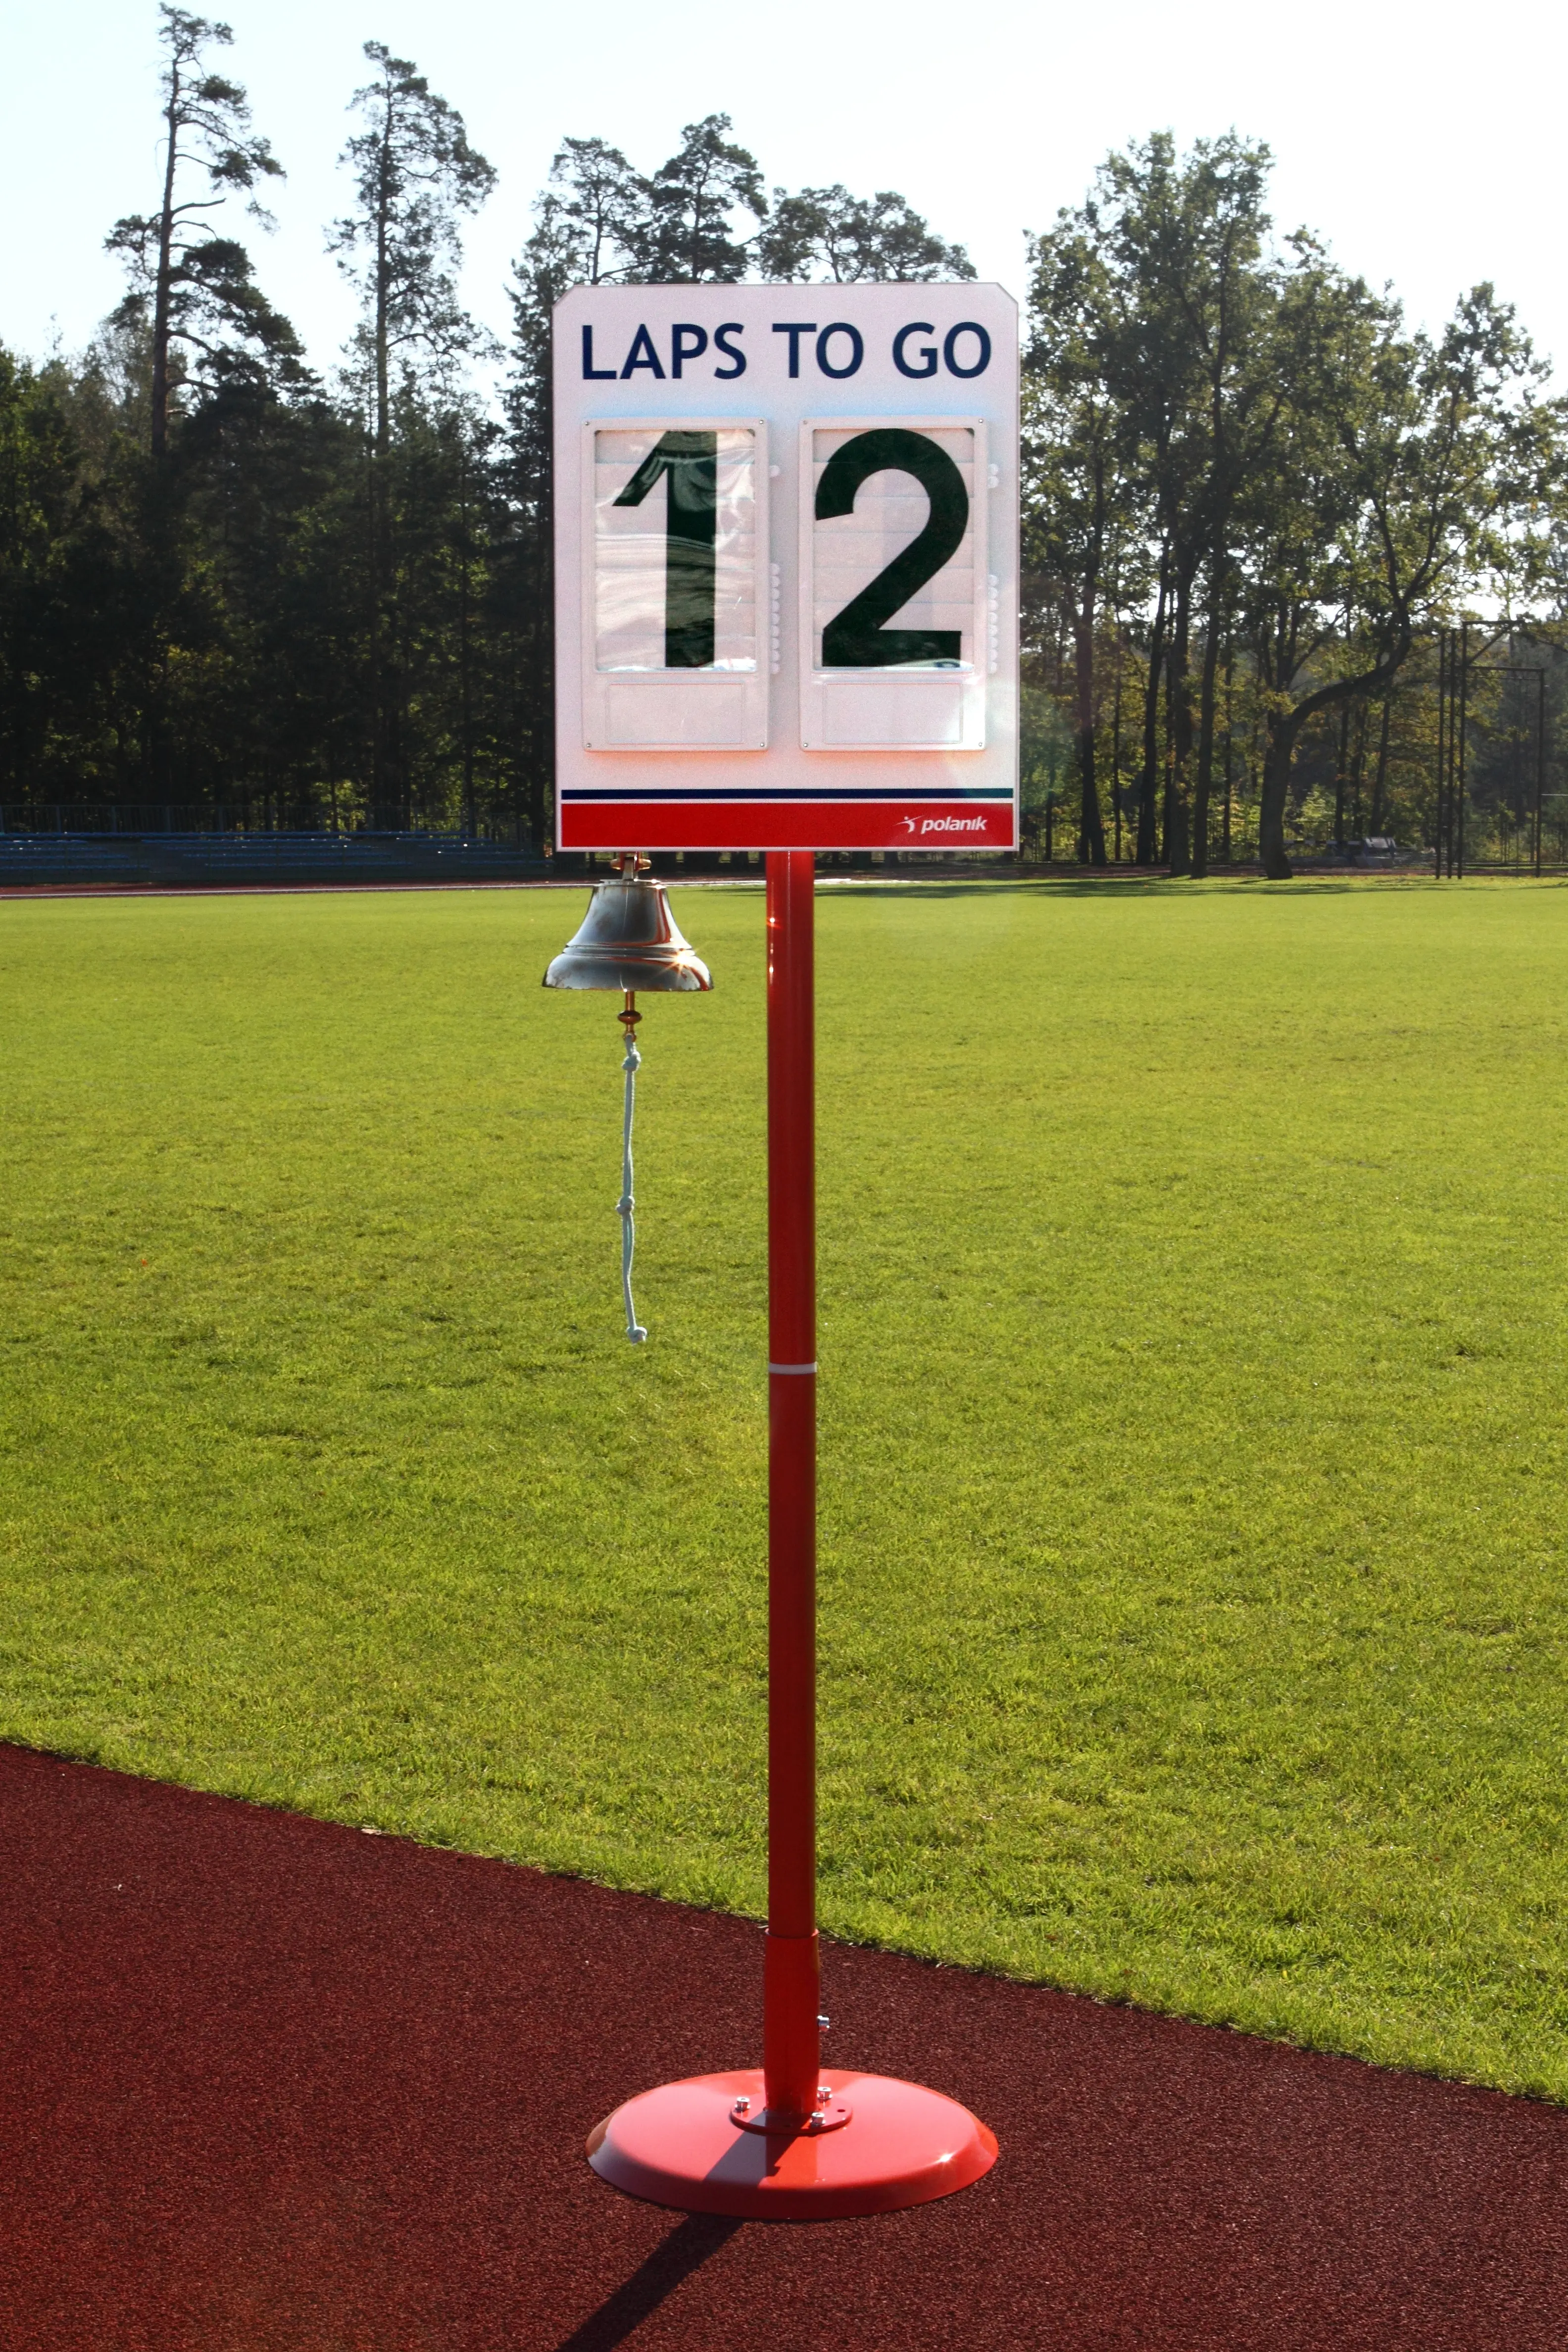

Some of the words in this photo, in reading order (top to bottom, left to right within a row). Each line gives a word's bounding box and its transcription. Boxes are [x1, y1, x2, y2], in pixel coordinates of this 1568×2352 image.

[581, 322, 747, 381] LAPS
[771, 322, 865, 380] TO
[891, 321, 992, 380] GO
[920, 816, 988, 835] polanik
